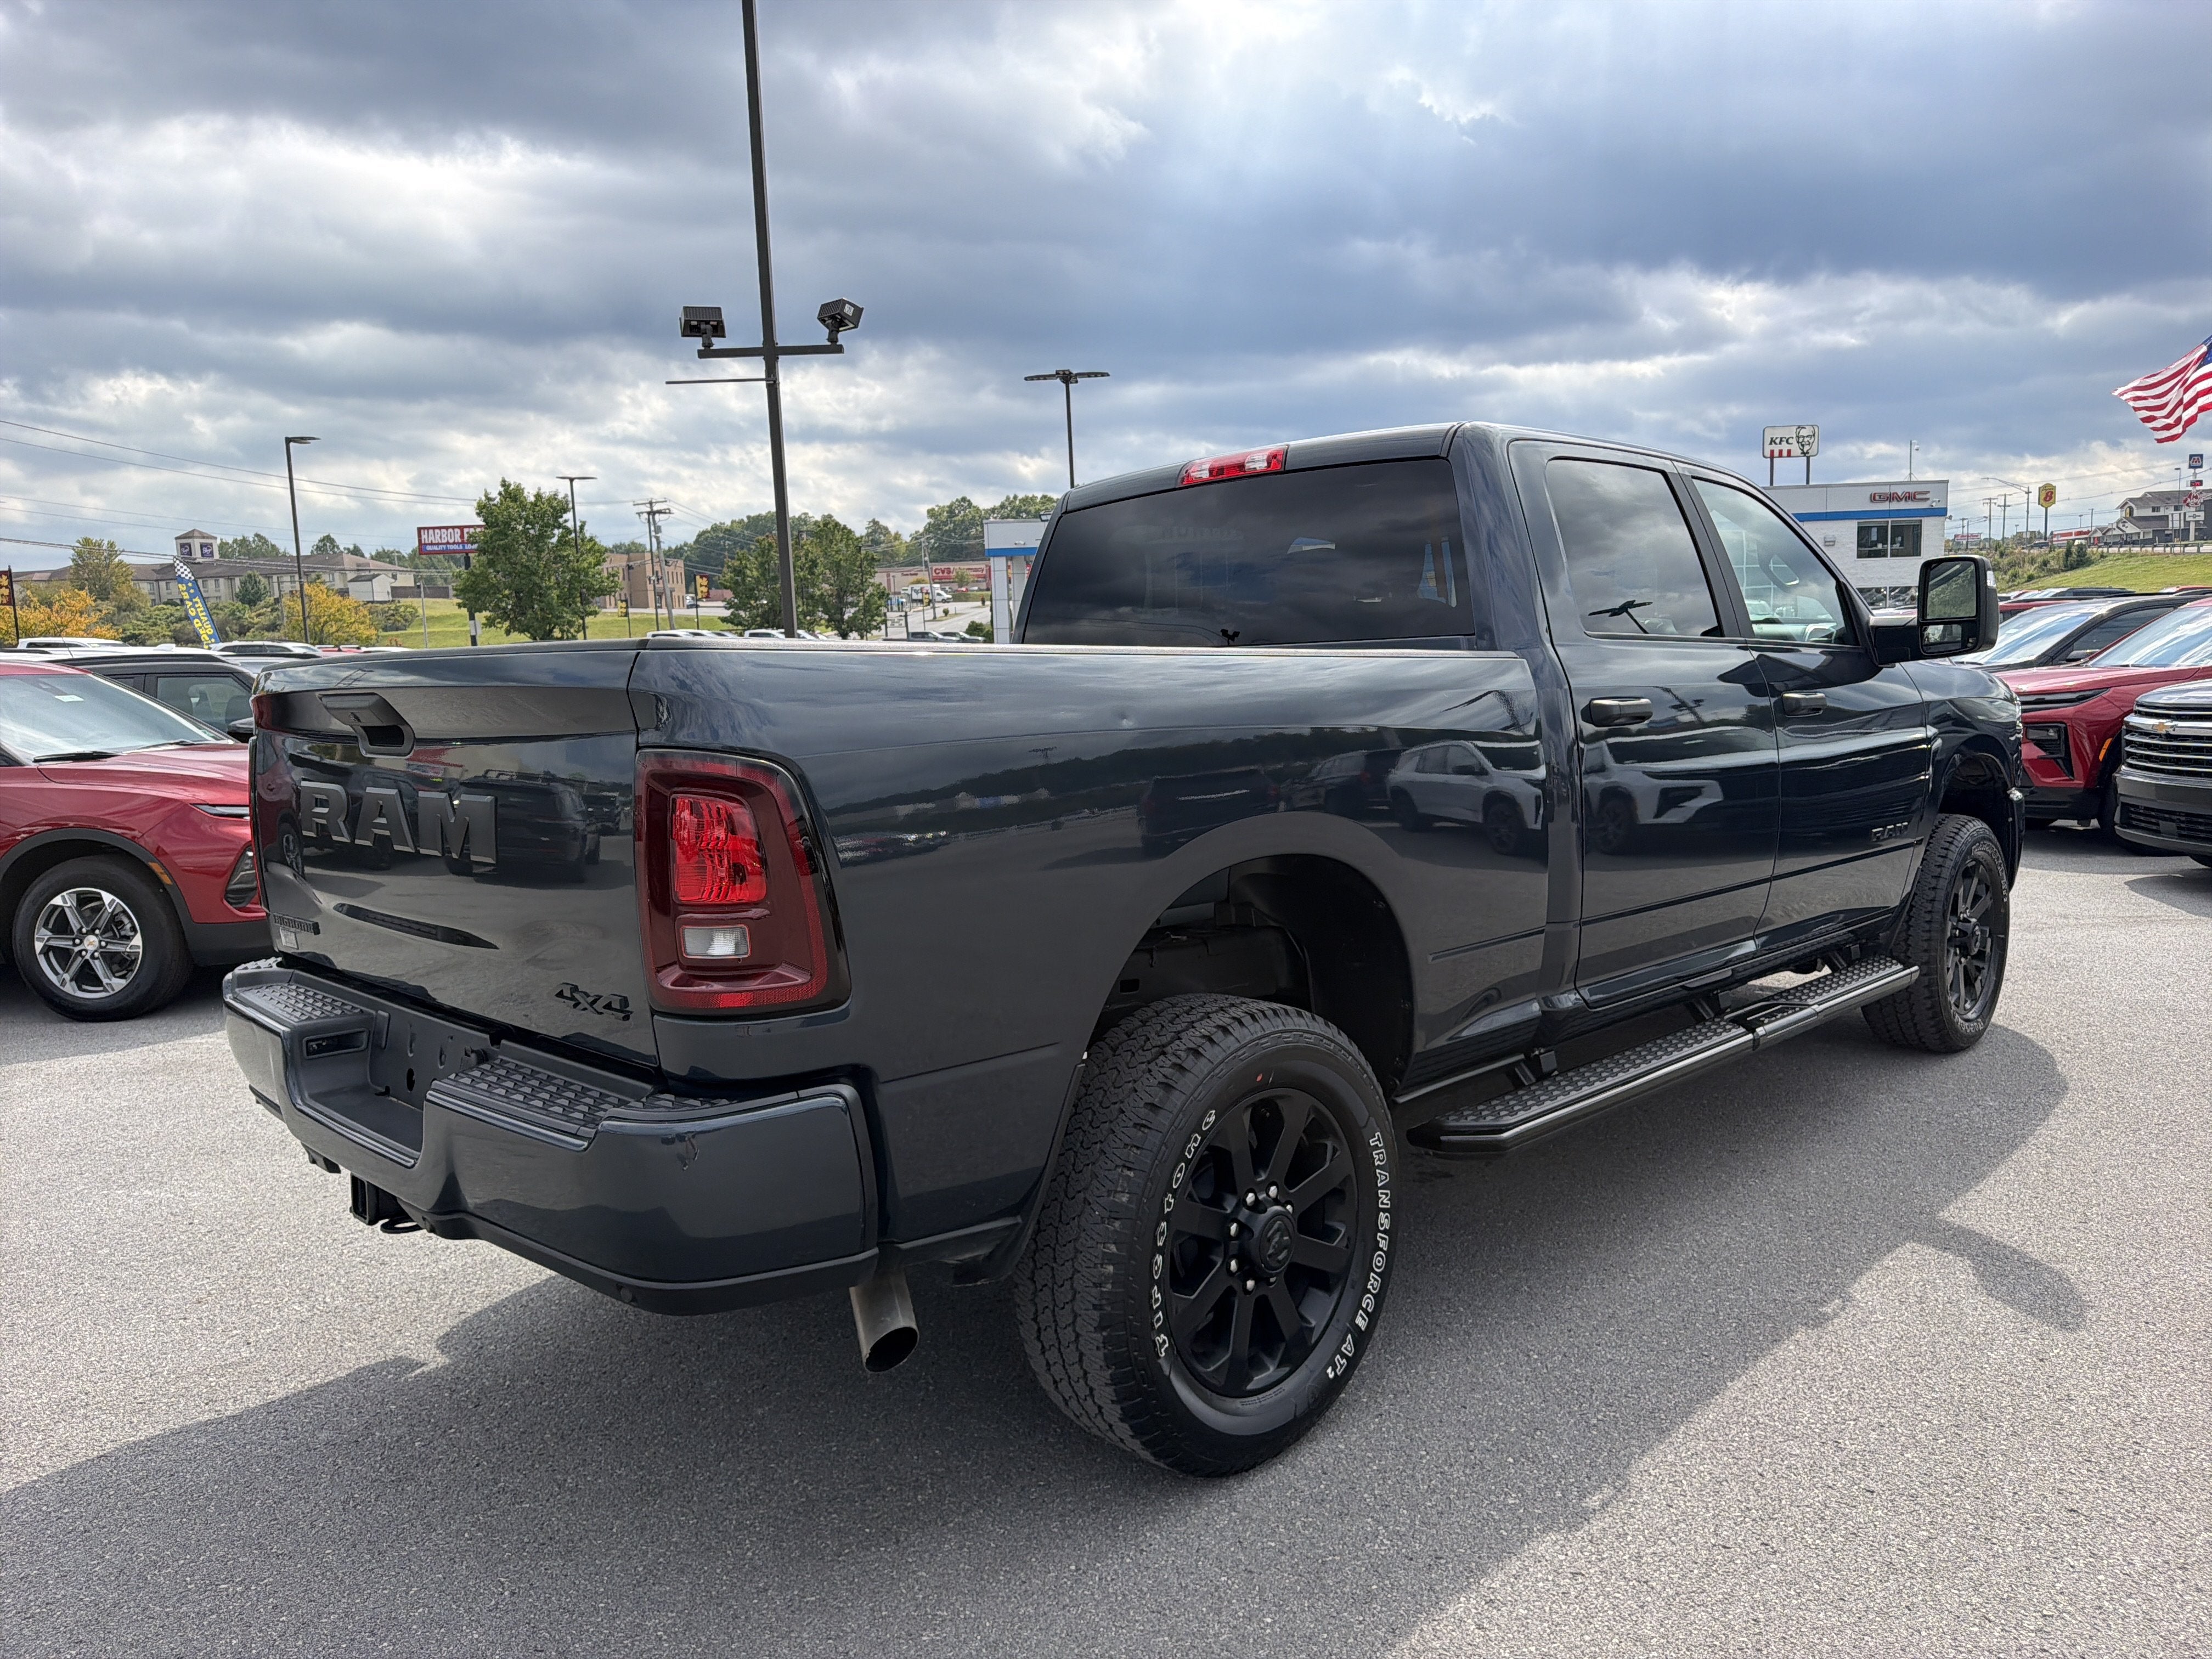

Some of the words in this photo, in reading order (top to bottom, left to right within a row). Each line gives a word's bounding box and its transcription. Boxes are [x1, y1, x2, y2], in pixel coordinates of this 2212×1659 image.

[1769, 436, 1794, 445] KFC
[1870, 490, 1931, 503] GMC
[2043, 491, 2054, 502] 8
[420, 528, 461, 544] HARBOR
[300, 780, 497, 864] RAM
[1870, 822, 1909, 842] RAM
[1355, 1131, 1391, 1332] TRANSFORCE
